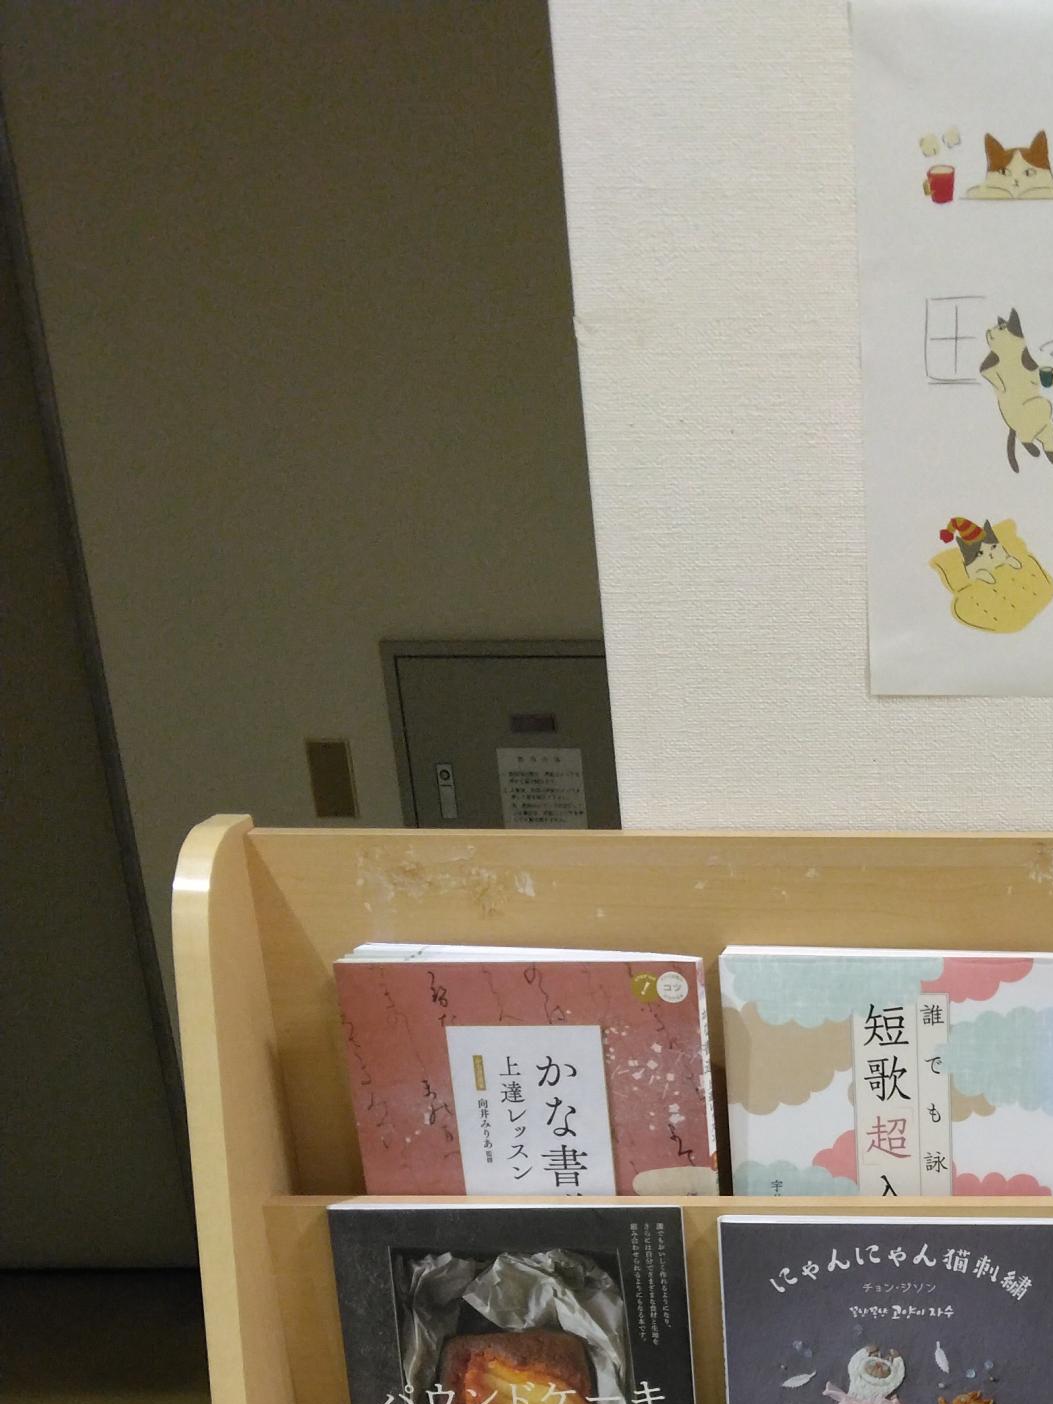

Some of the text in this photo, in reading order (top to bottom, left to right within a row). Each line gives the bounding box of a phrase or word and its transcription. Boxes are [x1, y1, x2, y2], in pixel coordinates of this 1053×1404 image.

[499, 1056, 533, 1181] 上達レッスン
[536, 1055, 588, 1196] かな書
[863, 1003, 912, 1196] 短歌超入
[919, 1005, 949, 1173] 誰でも詠
[769, 1243, 1033, 1300] にゃんにゃん猫刺繍
